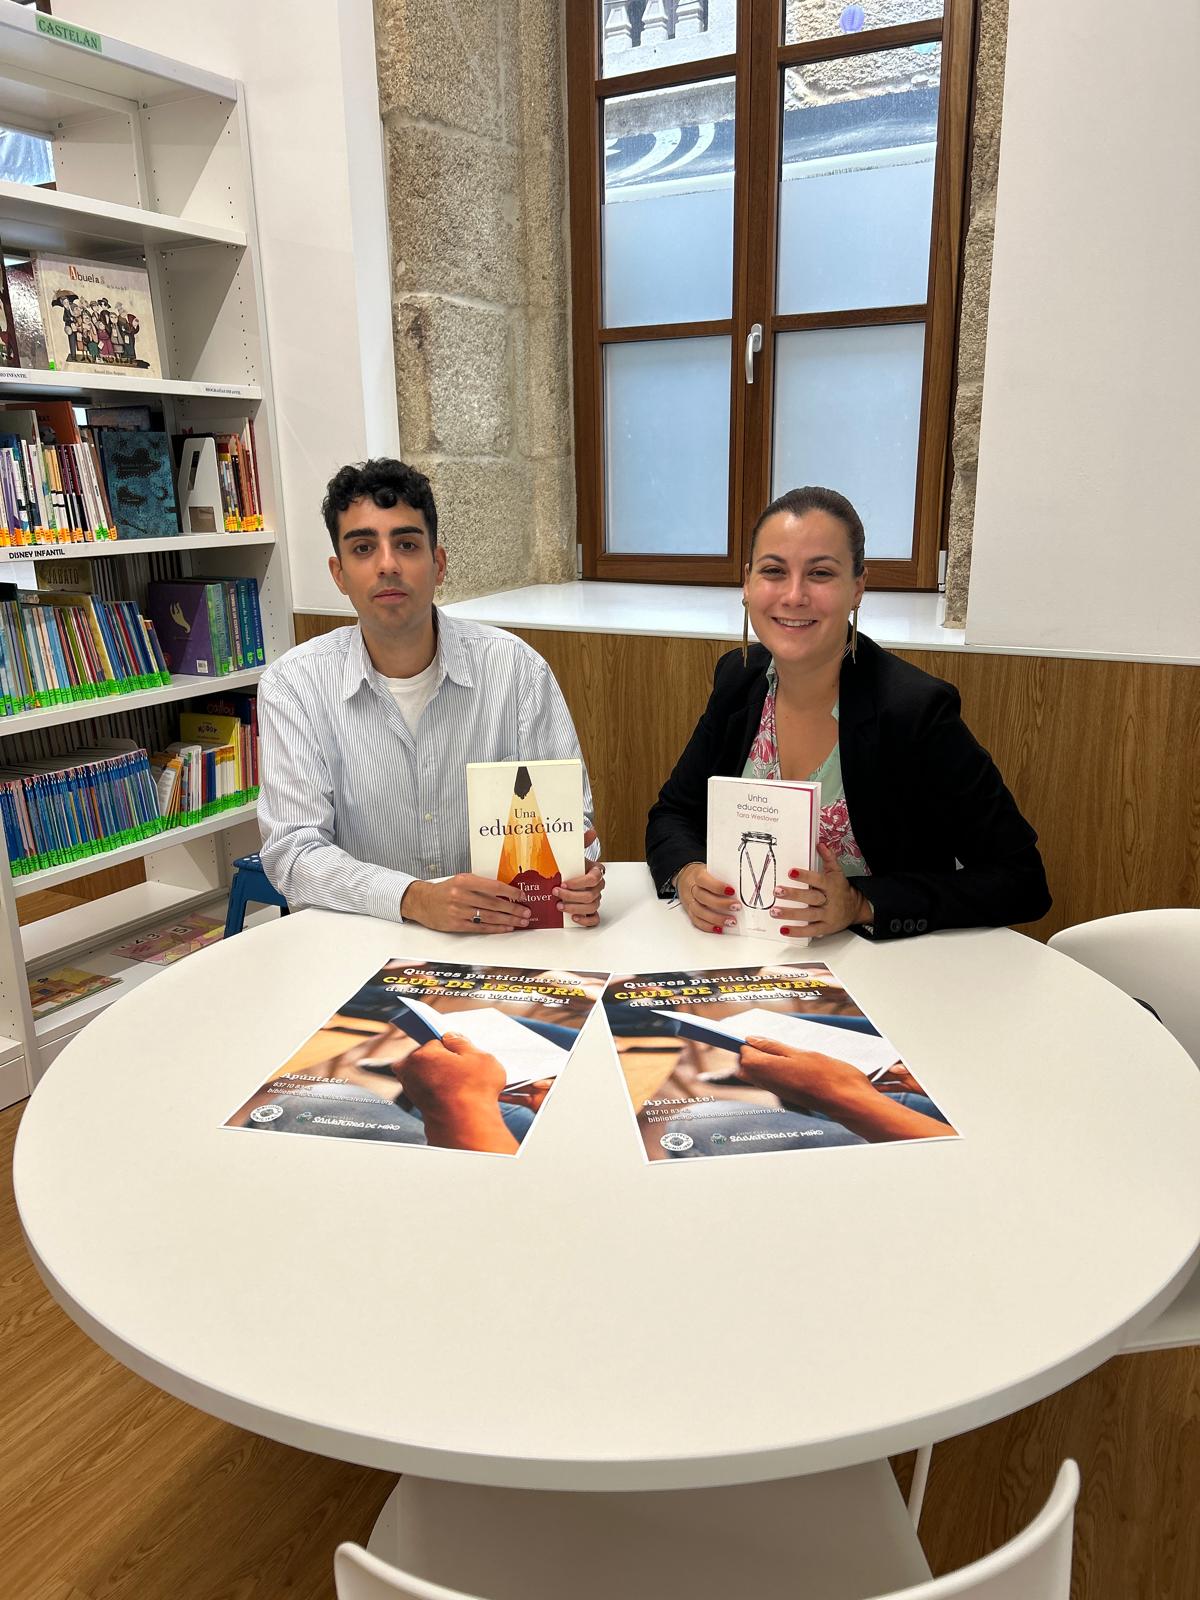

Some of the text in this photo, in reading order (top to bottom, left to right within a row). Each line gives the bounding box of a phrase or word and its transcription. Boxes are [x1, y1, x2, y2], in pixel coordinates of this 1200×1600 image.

[9, 548, 65, 559] DISNEY INFANTIL
[747, 794, 768, 804] Unha
[514, 808, 536, 819] Una
[736, 804, 778, 814] educación
[751, 814, 778, 822] Westover
[479, 817, 574, 837] educación
[518, 882, 540, 891] Tara
[403, 968, 462, 979] Queres
[464, 970, 556, 985] participar
[624, 979, 686, 990] Queres
[688, 974, 779, 987] participar
[383, 976, 586, 997] CLUB DE LECTURA
[614, 980, 829, 1000] CLUB DE LECTURA
[406, 987, 486, 999] Biblioteca
[650, 994, 737, 1007] Biblioteca
[280, 1072, 350, 1085] Apúntate!
[642, 1095, 716, 1107] Apúntate!
